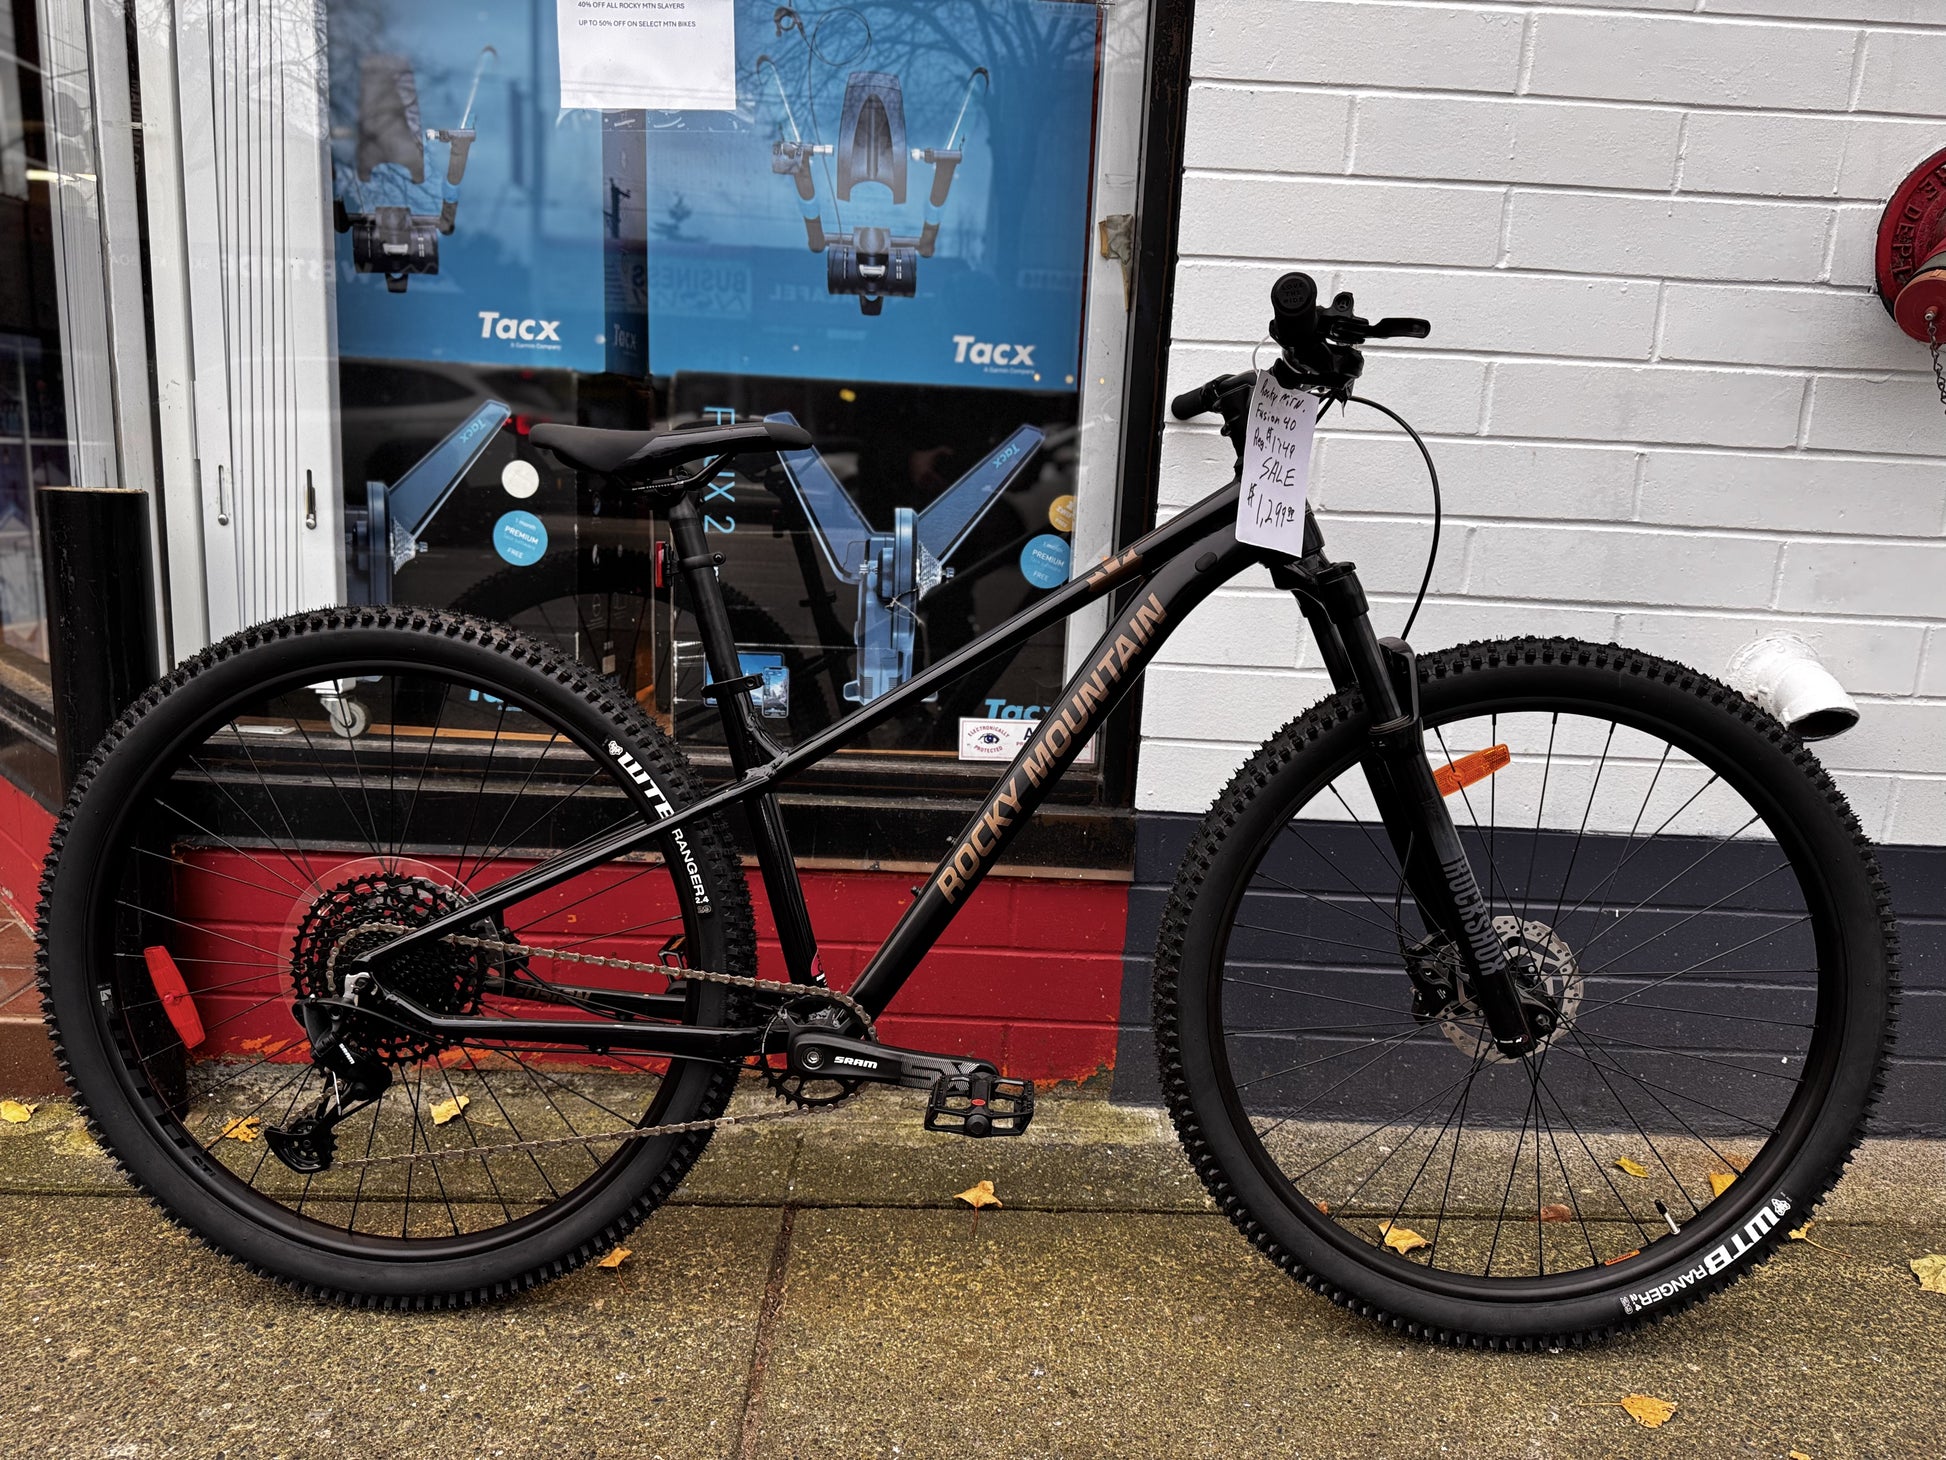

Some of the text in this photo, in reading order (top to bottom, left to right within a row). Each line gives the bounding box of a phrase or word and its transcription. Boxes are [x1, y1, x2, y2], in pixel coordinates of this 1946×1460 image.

[657, 2, 685, 10] SLAYERS
[638, 20, 662, 28] SELECT
[662, 20, 677, 28] MTN
[677, 20, 696, 28] BIKES
[478, 311, 561, 342] Tacx
[613, 323, 637, 350] Tacx
[952, 334, 1036, 366] Tacx
[1256, 402, 1297, 431] Fusion 40
[459, 418, 487, 444] Tacx
[992, 443, 1021, 469] Tacx
[1259, 456, 1296, 487] SALE
[504, 525, 539, 545] PREMIUM
[703, 514, 736, 534] 2
[507, 547, 524, 559] FREE
[1031, 549, 1065, 568] PREMIUM
[1033, 570, 1049, 582] FREE
[967, 725, 1010, 738] ELECTRONICALLY
[936, 592, 1168, 905] ROCKY MOUNTAIN
[973, 744, 1003, 754] PROTECTED
[671, 828, 705, 897] RANGER
[695, 895, 710, 904] 2.4
[1443, 855, 1508, 977] ROCKSHOX
[834, 1055, 878, 1070] SRAM
[1638, 1206, 1781, 1311] WTB RANGER
